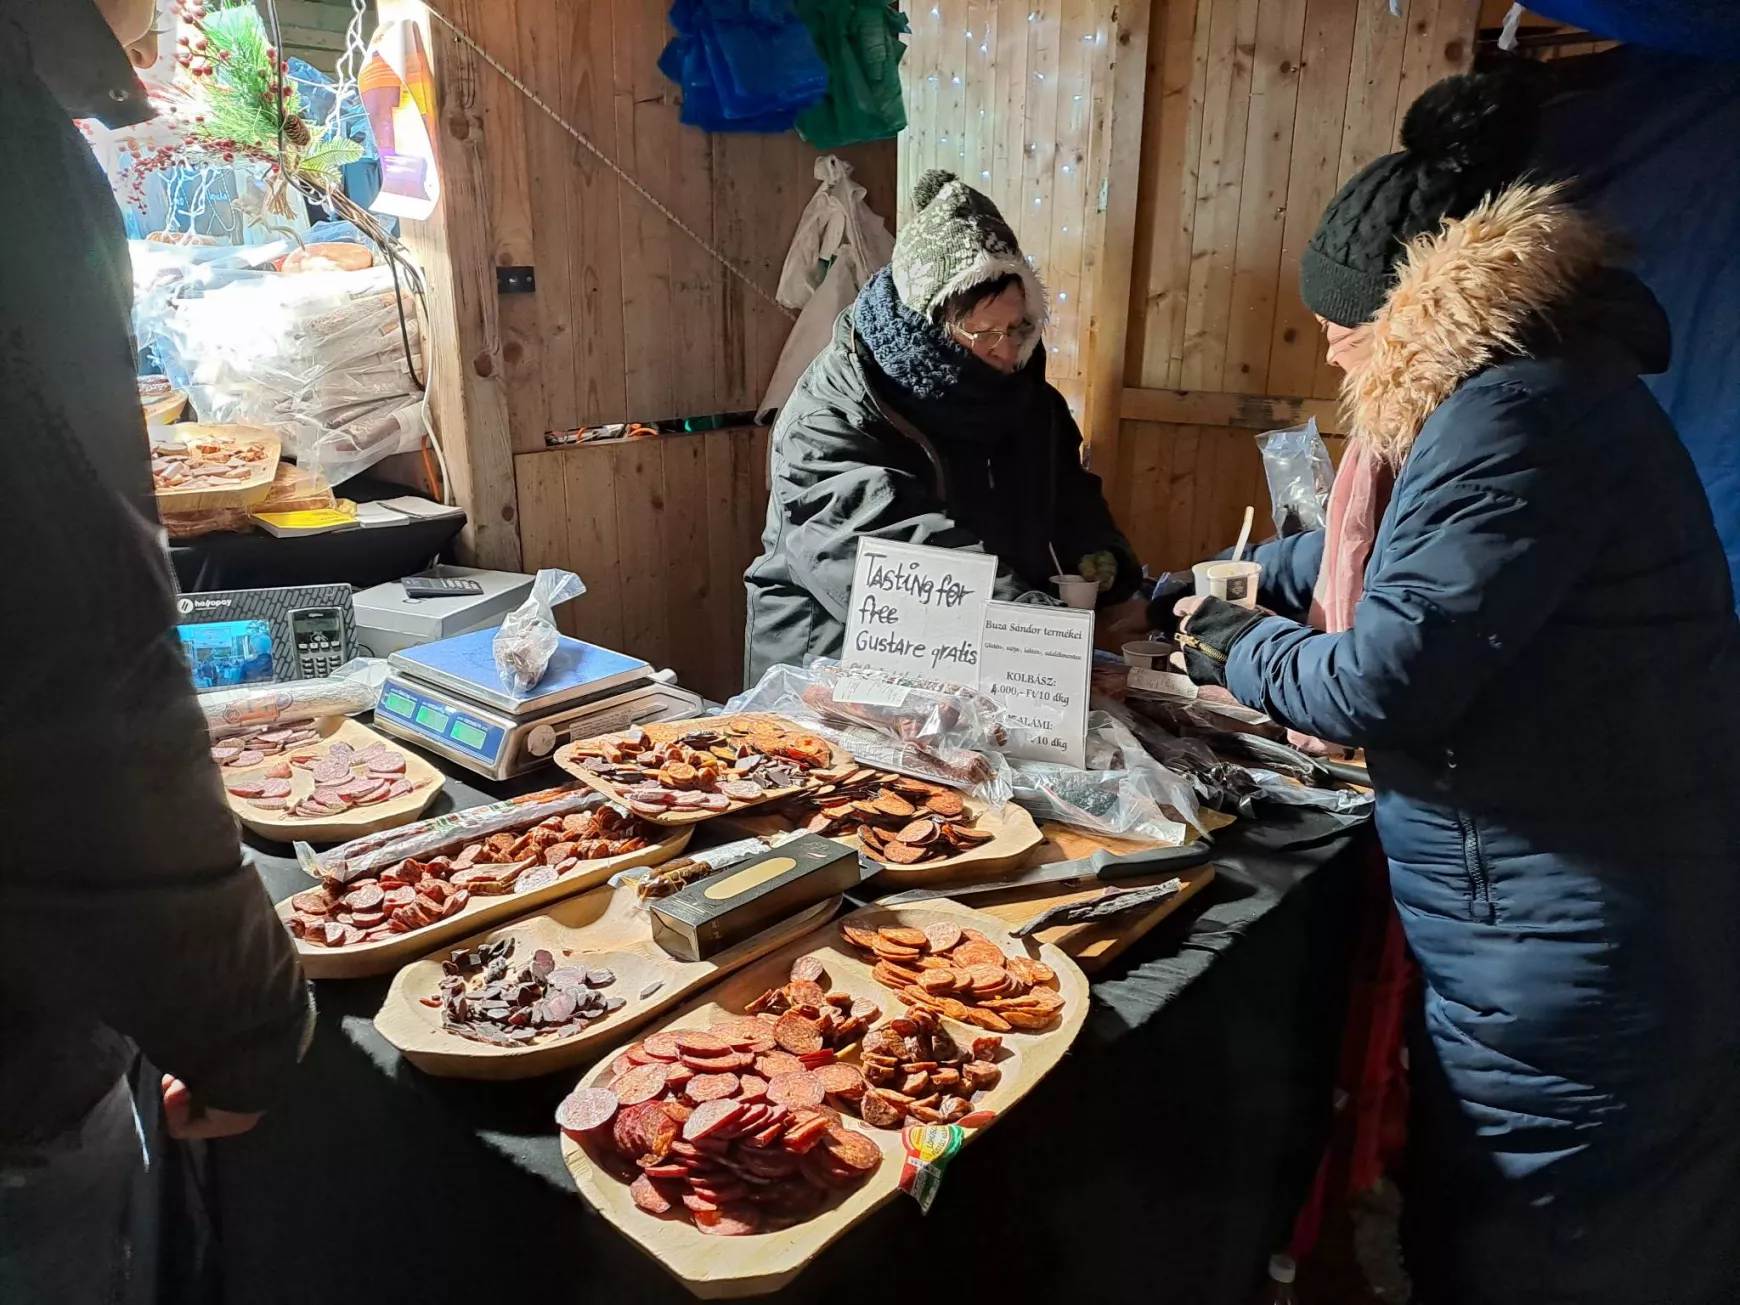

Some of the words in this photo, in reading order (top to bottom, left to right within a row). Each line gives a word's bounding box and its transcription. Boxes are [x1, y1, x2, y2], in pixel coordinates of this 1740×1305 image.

[864, 552, 934, 605] Tasting
[935, 574, 975, 607] for
[858, 594, 899, 624] free
[985, 620, 1007, 630] Buza
[1009, 623, 1042, 635] Sándor
[1044, 627, 1082, 640] termékei
[856, 630, 926, 658] Gustare
[1006, 671, 1057, 687] KOLBÁSZ:
[1052, 692, 1070, 707] dkg
[1051, 737, 1068, 751] dkg
